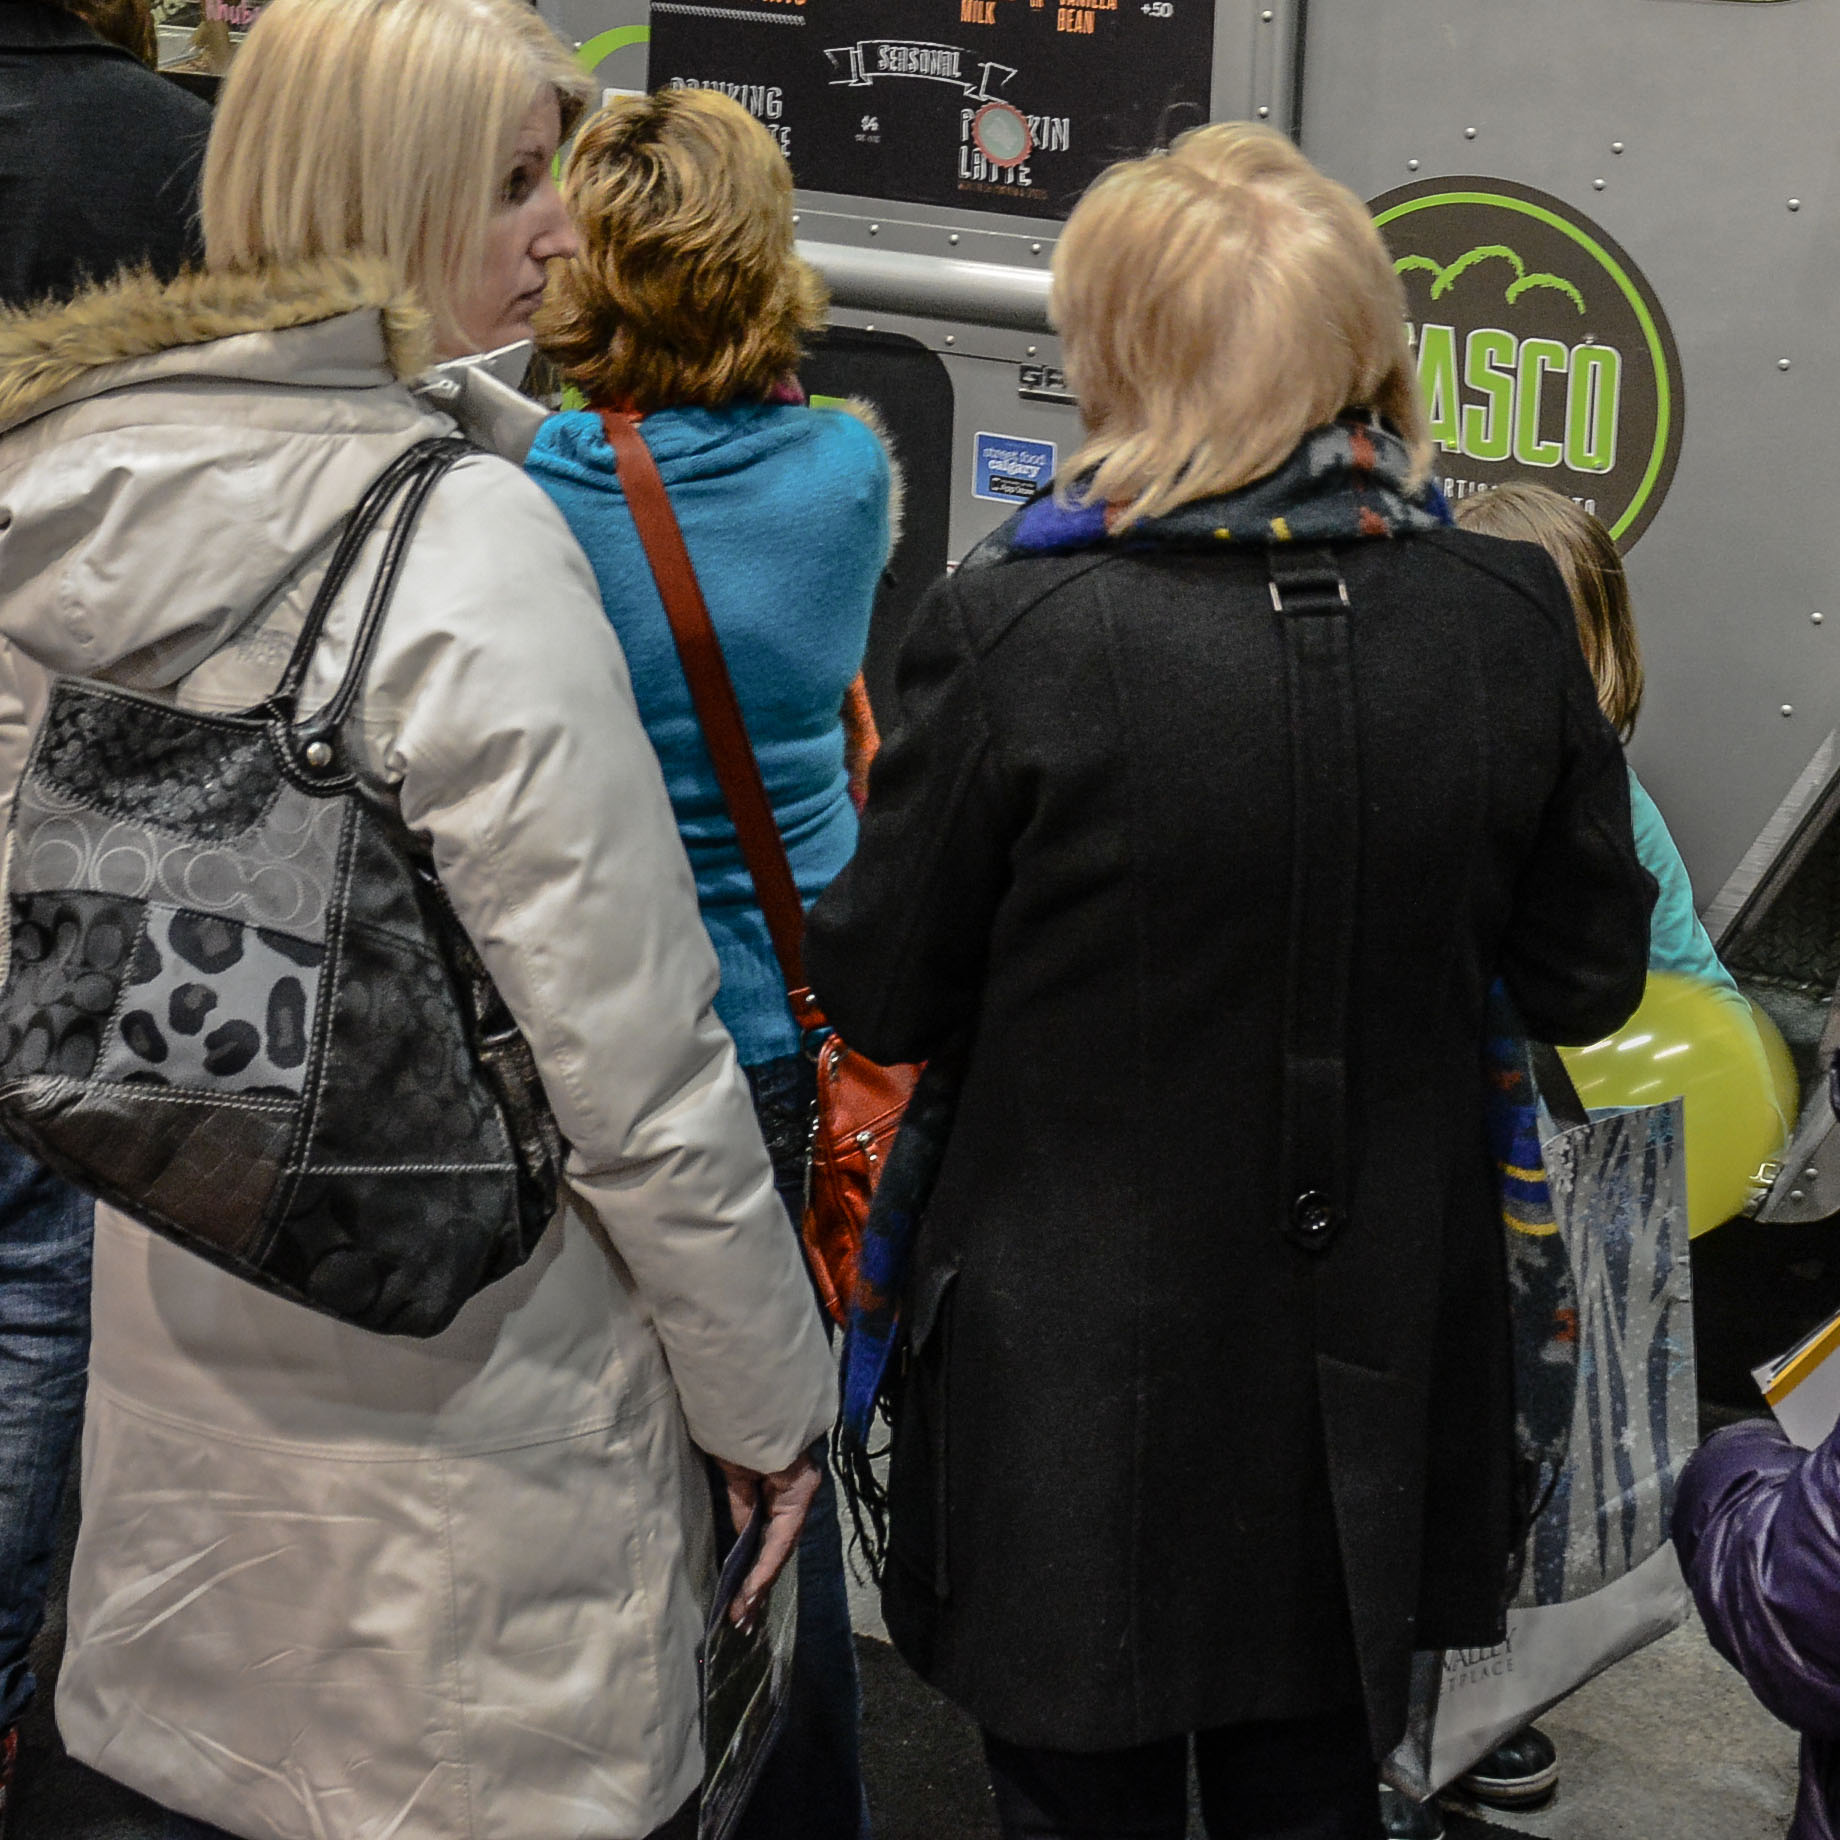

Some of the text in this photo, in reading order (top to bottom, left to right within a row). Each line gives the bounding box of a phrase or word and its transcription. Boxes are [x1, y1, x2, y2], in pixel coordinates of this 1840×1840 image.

[960, 0, 1096, 35] MILK BEAN
[876, 44, 962, 79] SEASONAL
[960, 107, 1071, 152] PKIN
[1407, 322, 1623, 476] ASCO
[987, 459, 1042, 479] calgary
